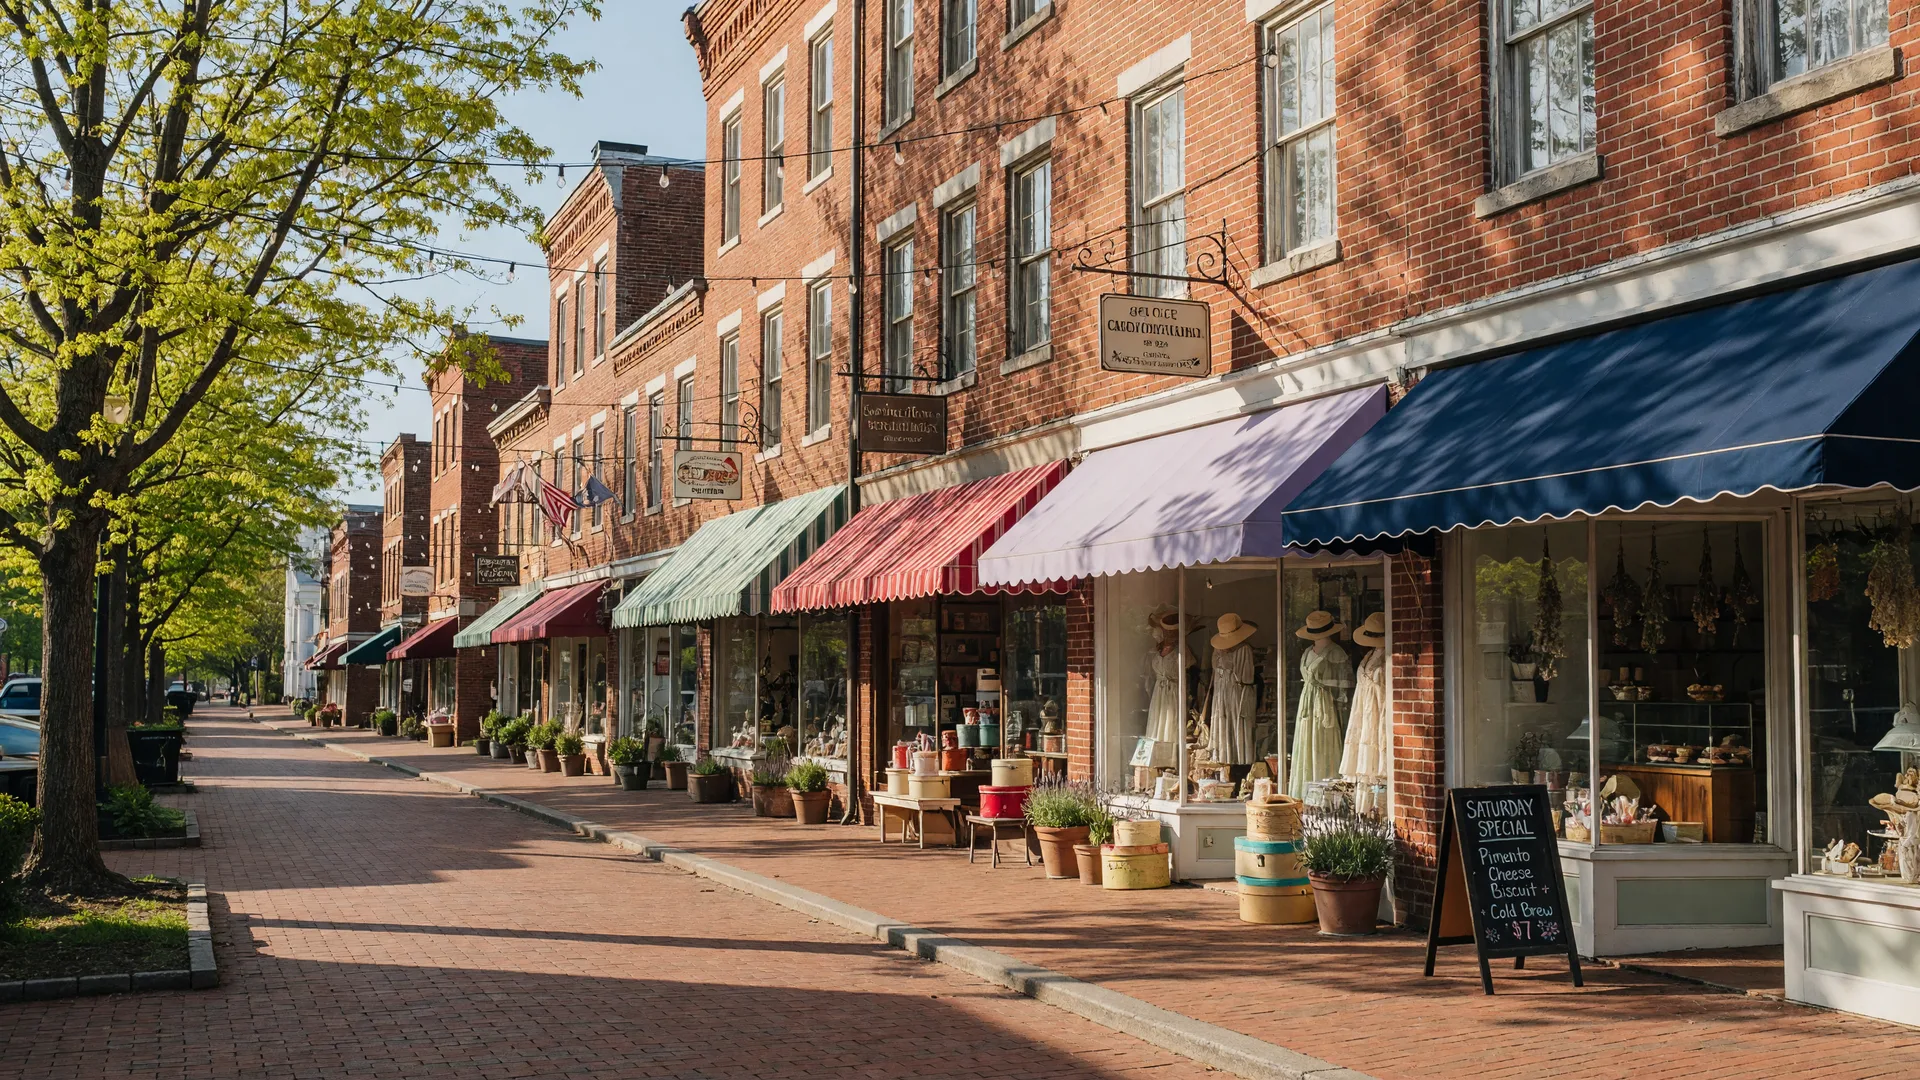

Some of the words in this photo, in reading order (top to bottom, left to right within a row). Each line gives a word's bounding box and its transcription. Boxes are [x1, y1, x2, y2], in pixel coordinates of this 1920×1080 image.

[1466, 799, 1534, 818] SATURDAY
[1478, 820, 1534, 837] SPECIAL
[1479, 847, 1531, 865] Pimento
[1488, 866, 1533, 881] Cheese
[1490, 882, 1537, 899] Biscuit
[1490, 904, 1517, 919] Cold
[1521, 902, 1553, 917] Brew
[1512, 920, 1531, 940] $7
